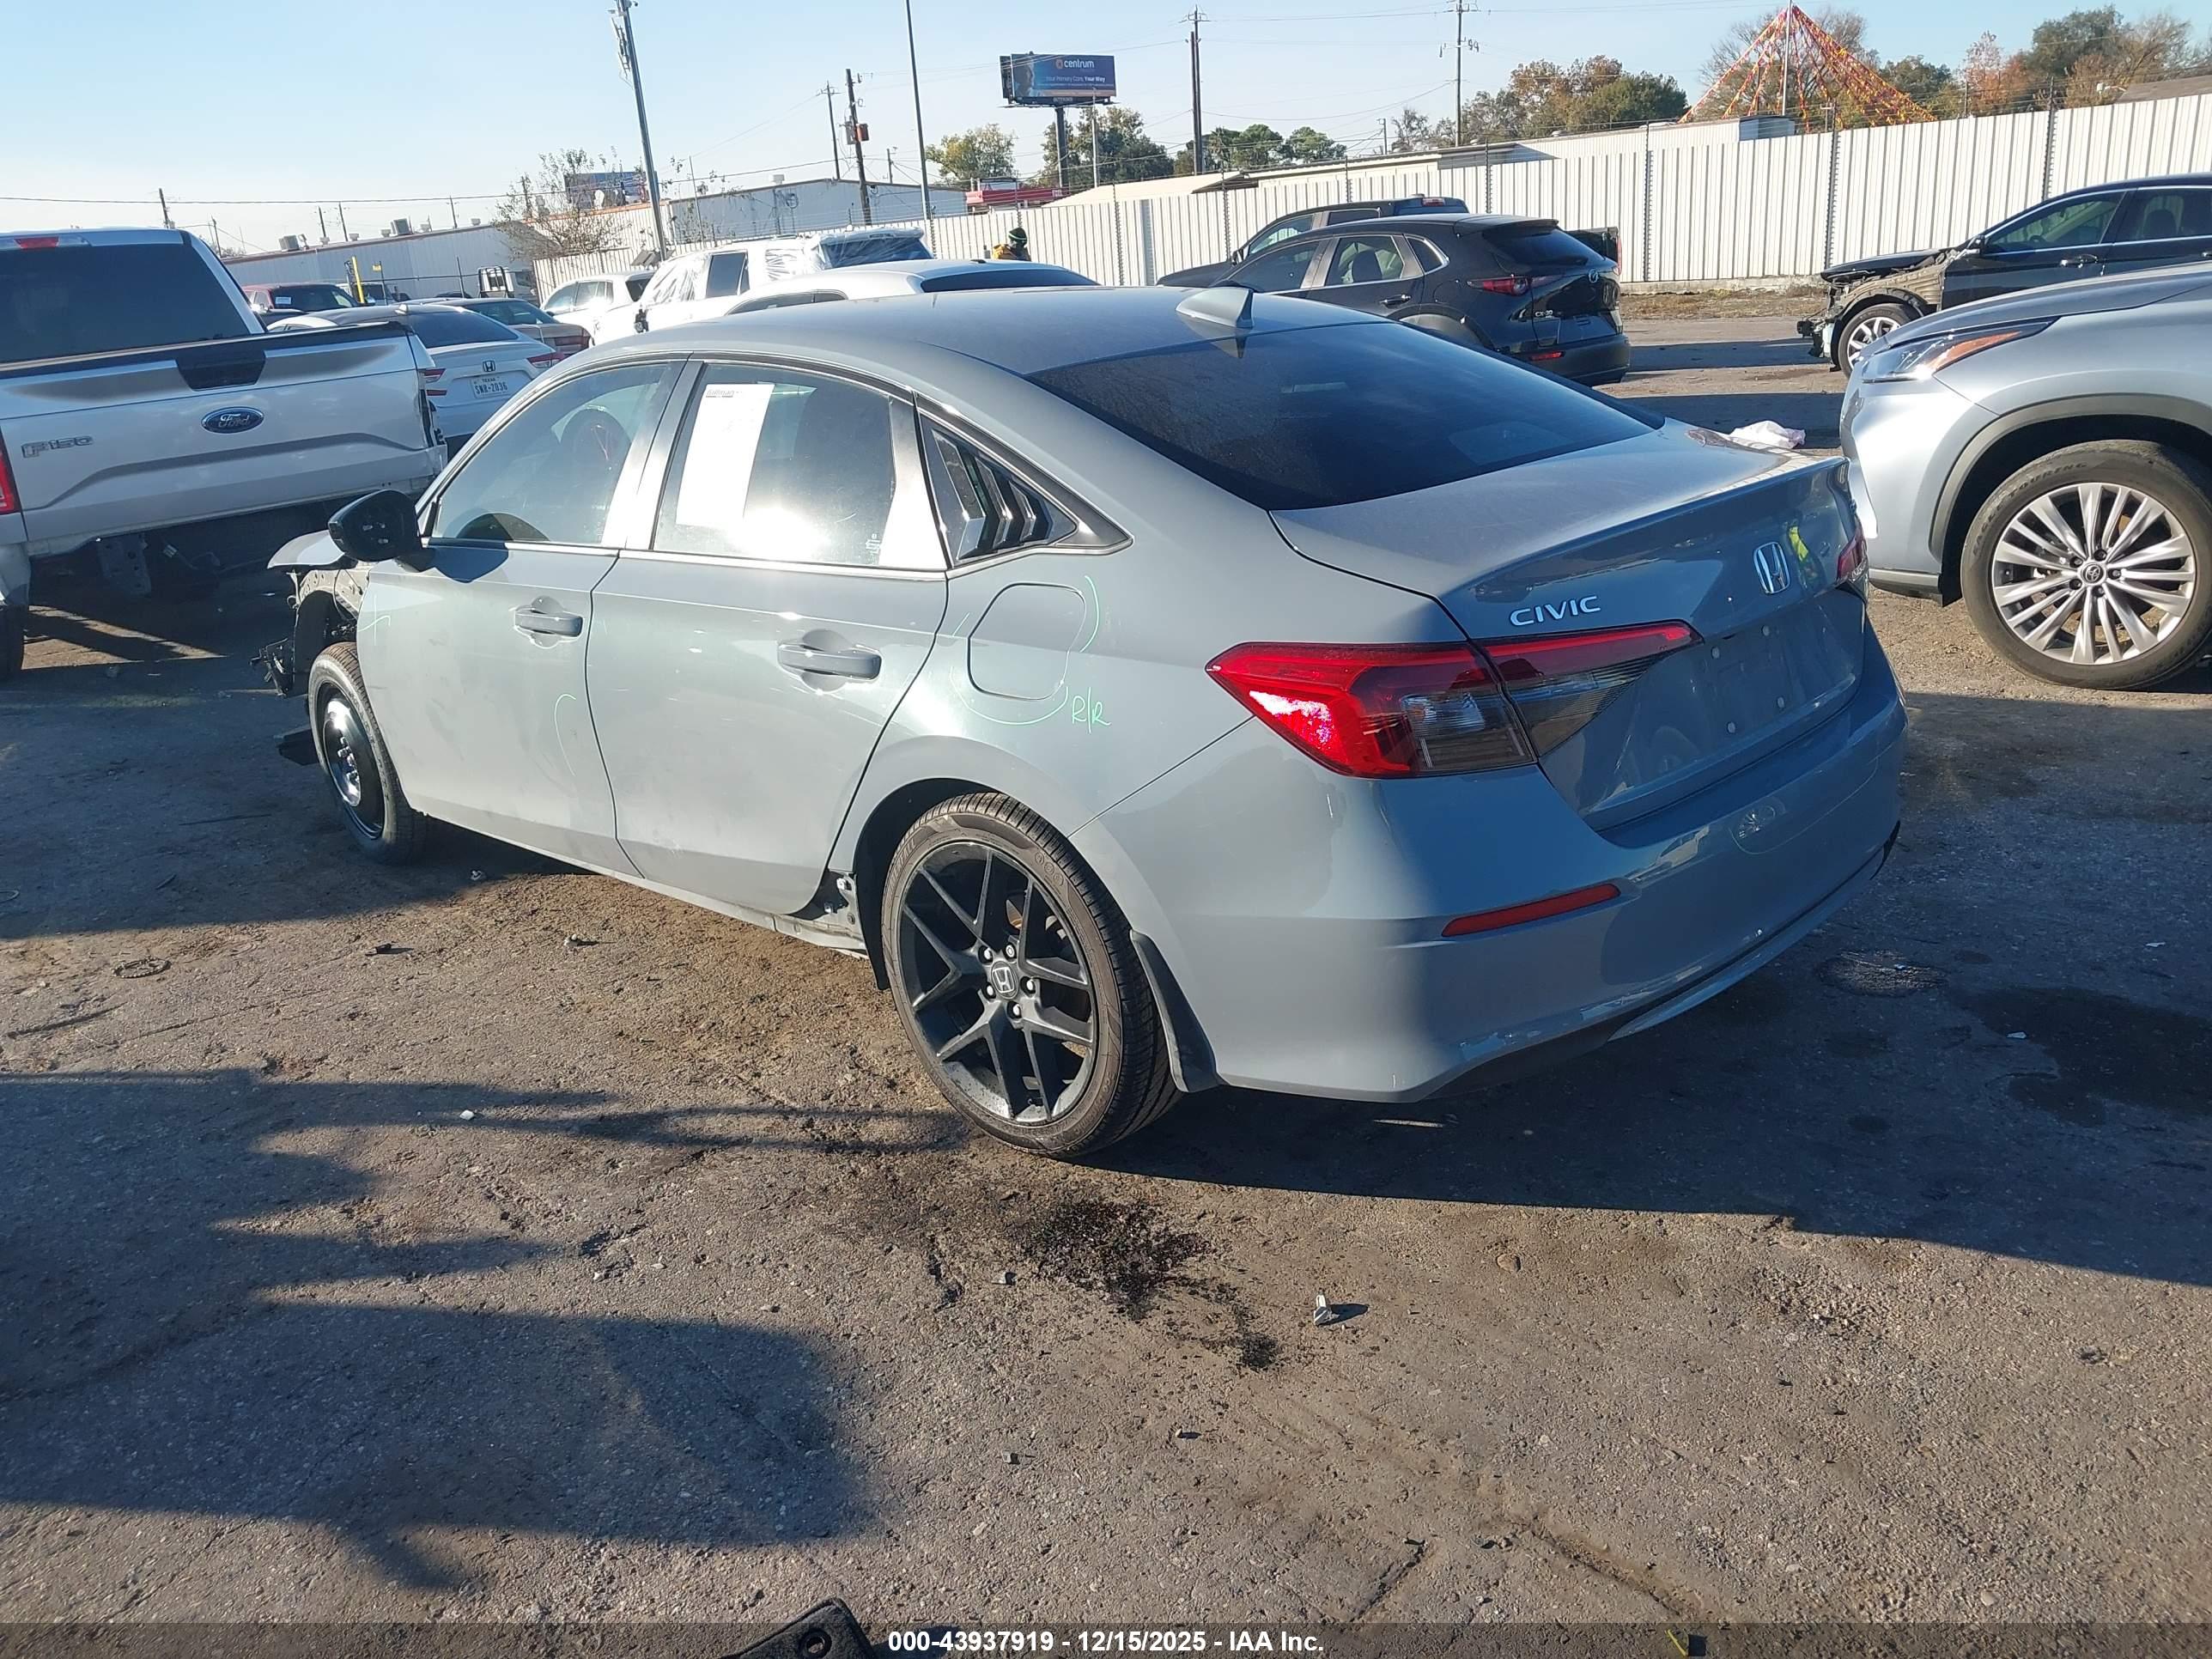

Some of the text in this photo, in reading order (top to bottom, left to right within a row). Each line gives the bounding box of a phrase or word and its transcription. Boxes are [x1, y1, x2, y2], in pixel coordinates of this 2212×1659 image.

[1064, 58, 1095, 69] centrum
[218, 413, 250, 428] Ford
[2007, 462, 2087, 499] TOURING
[1509, 595, 1602, 627] CIVIC
